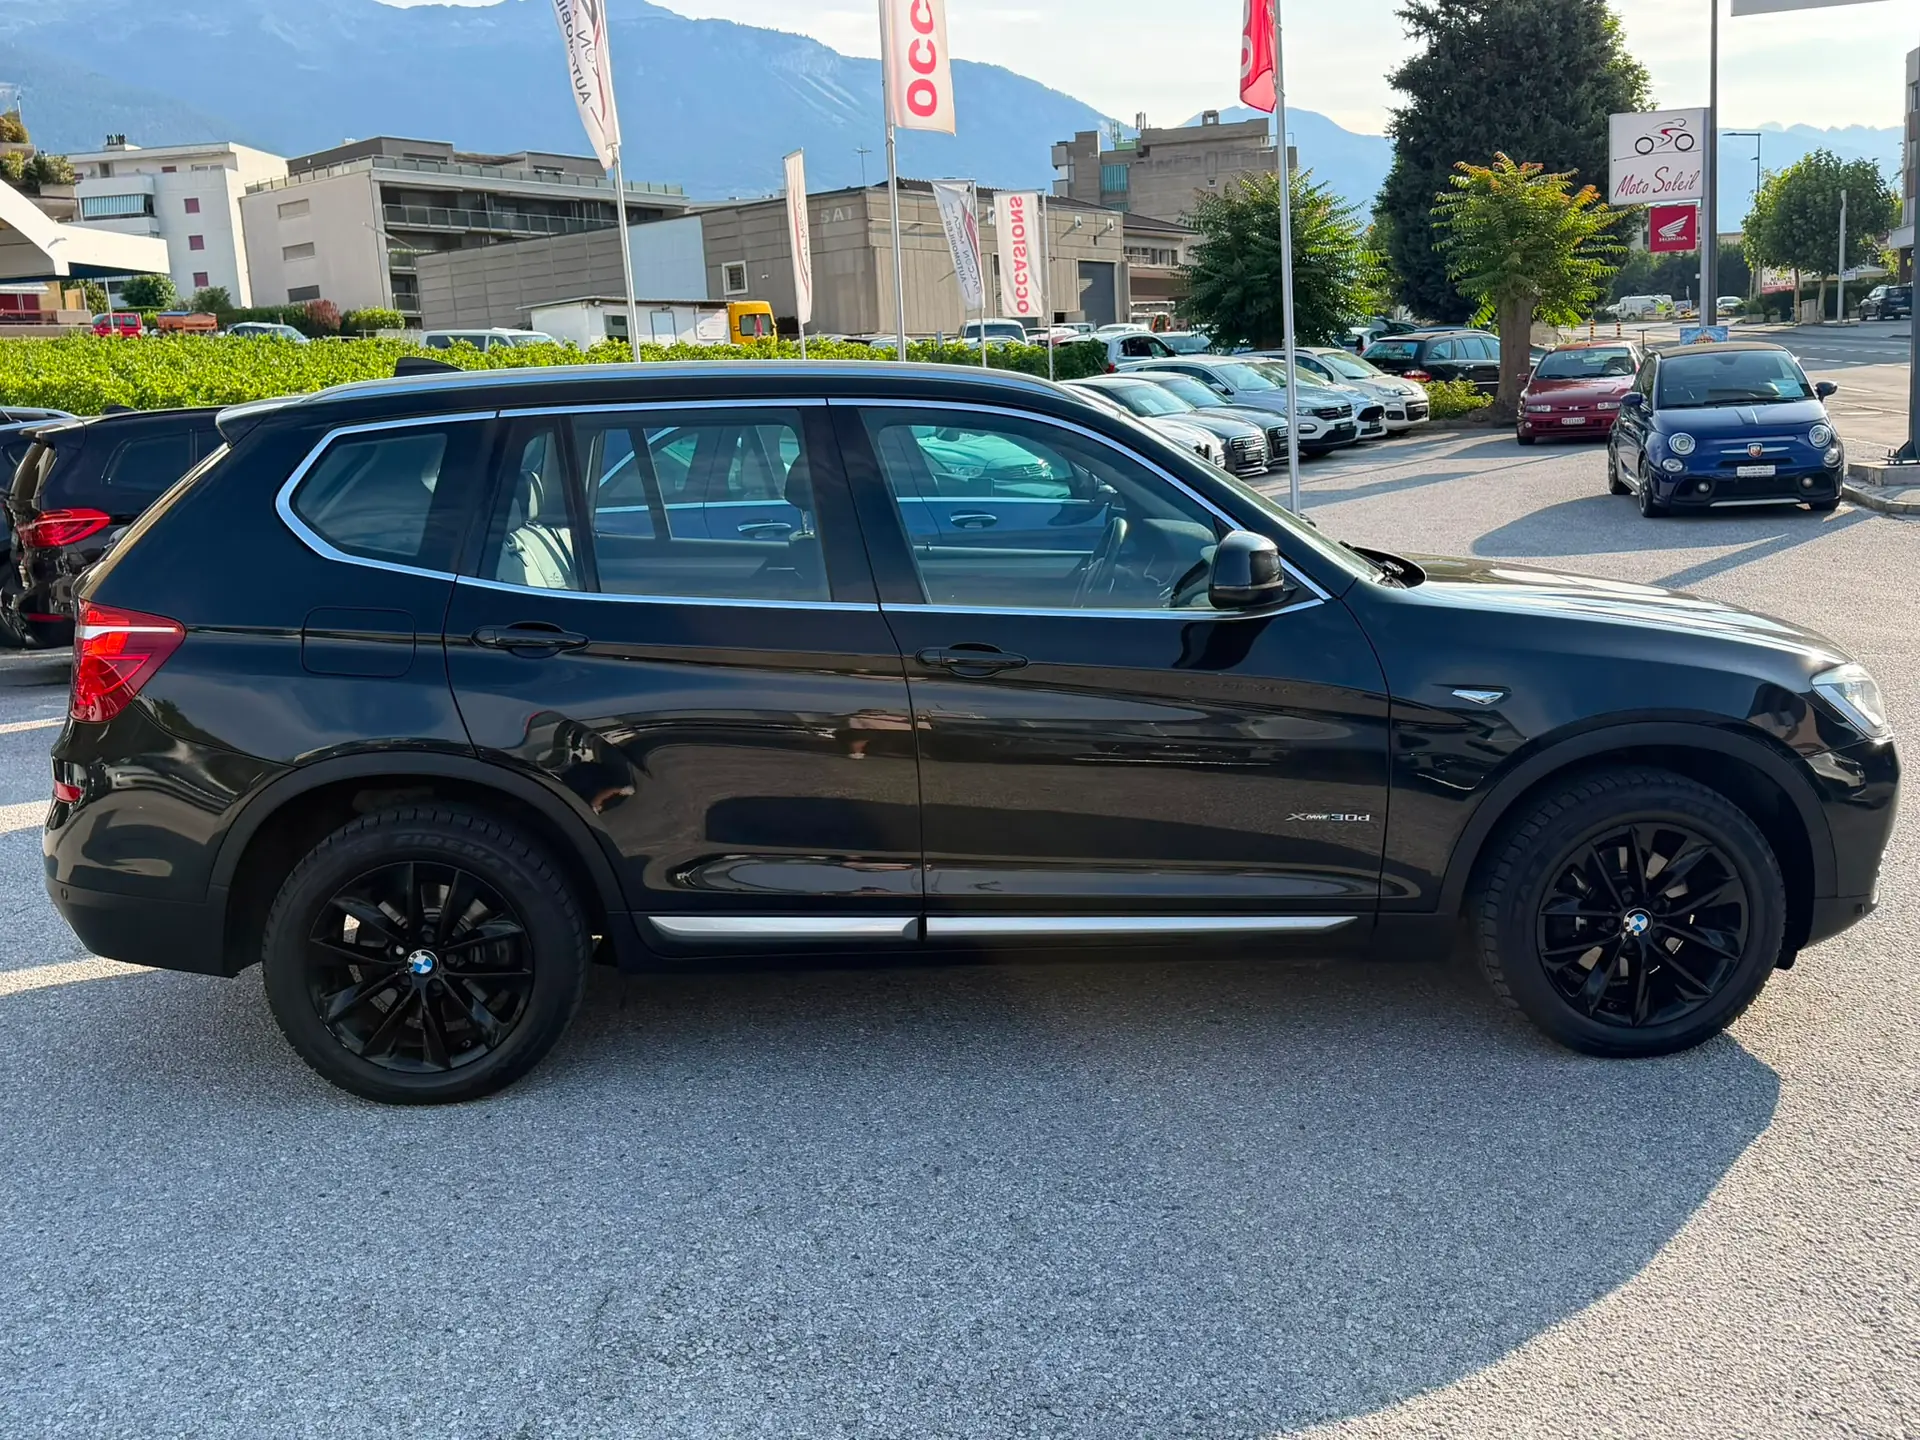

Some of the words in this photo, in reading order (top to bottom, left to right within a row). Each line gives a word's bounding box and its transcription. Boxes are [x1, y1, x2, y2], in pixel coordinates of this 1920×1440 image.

[1614, 174, 1649, 198] Moto
[1652, 166, 1701, 194] Soleil
[1658, 235, 1688, 243] HONDA
